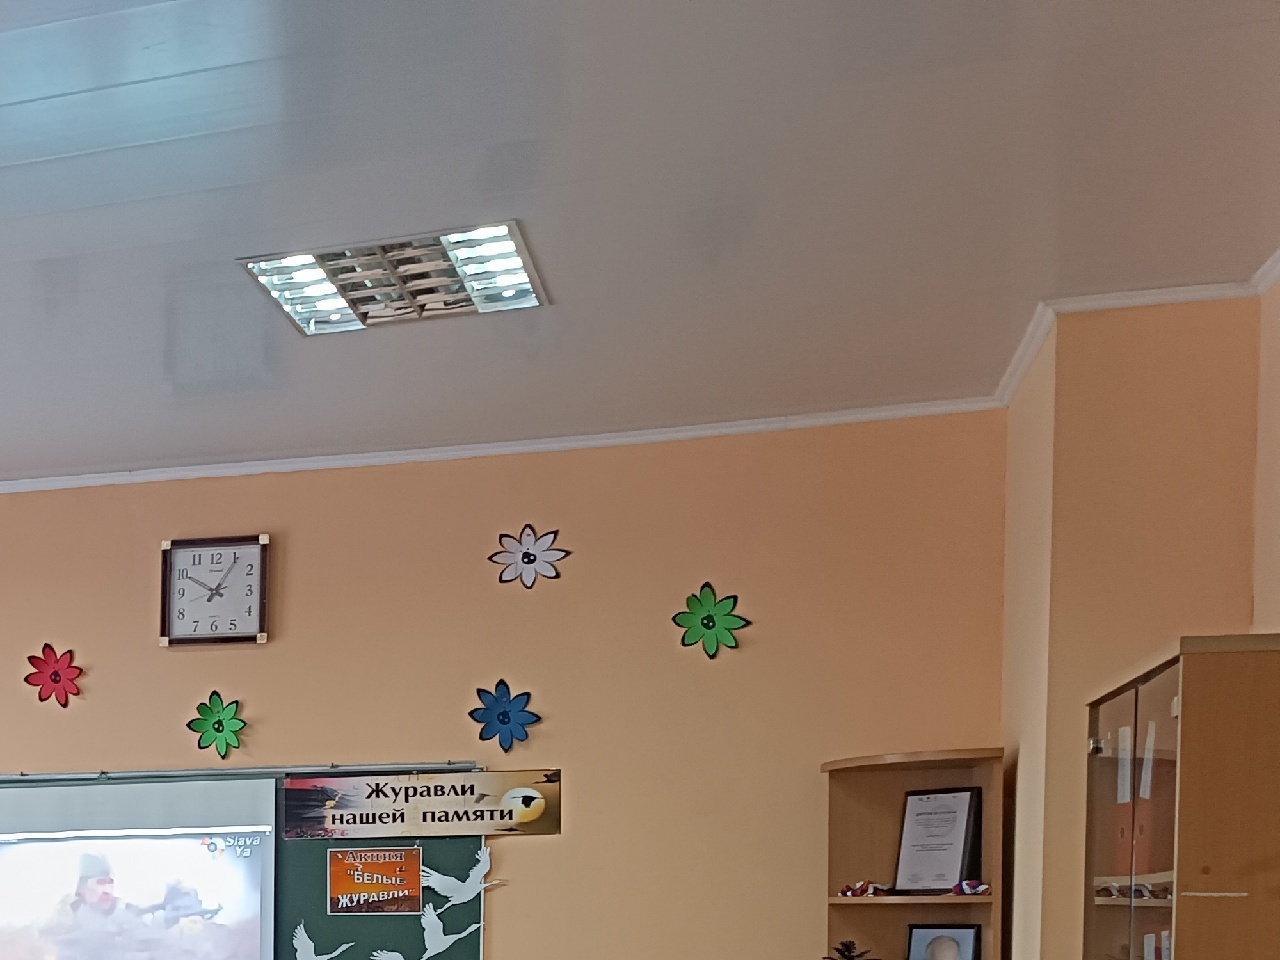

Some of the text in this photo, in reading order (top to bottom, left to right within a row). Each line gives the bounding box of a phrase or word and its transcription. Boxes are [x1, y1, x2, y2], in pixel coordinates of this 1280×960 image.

[191, 553, 202, 566] 11
[210, 552, 223, 565] 12
[176, 568, 189, 581] 10
[245, 563, 254, 576] 2
[177, 587, 186, 600] 9
[245, 584, 254, 597] 3
[177, 607, 186, 620] 8
[244, 605, 253, 617] 4
[192, 620, 200, 632] 7
[210, 619, 219, 632] 6
[228, 619, 238, 631] 5
[365, 782, 475, 803] Журавли
[331, 808, 514, 825] нашей памяти
[225, 835, 261, 846] Slava
[235, 846, 251, 857] Ya
